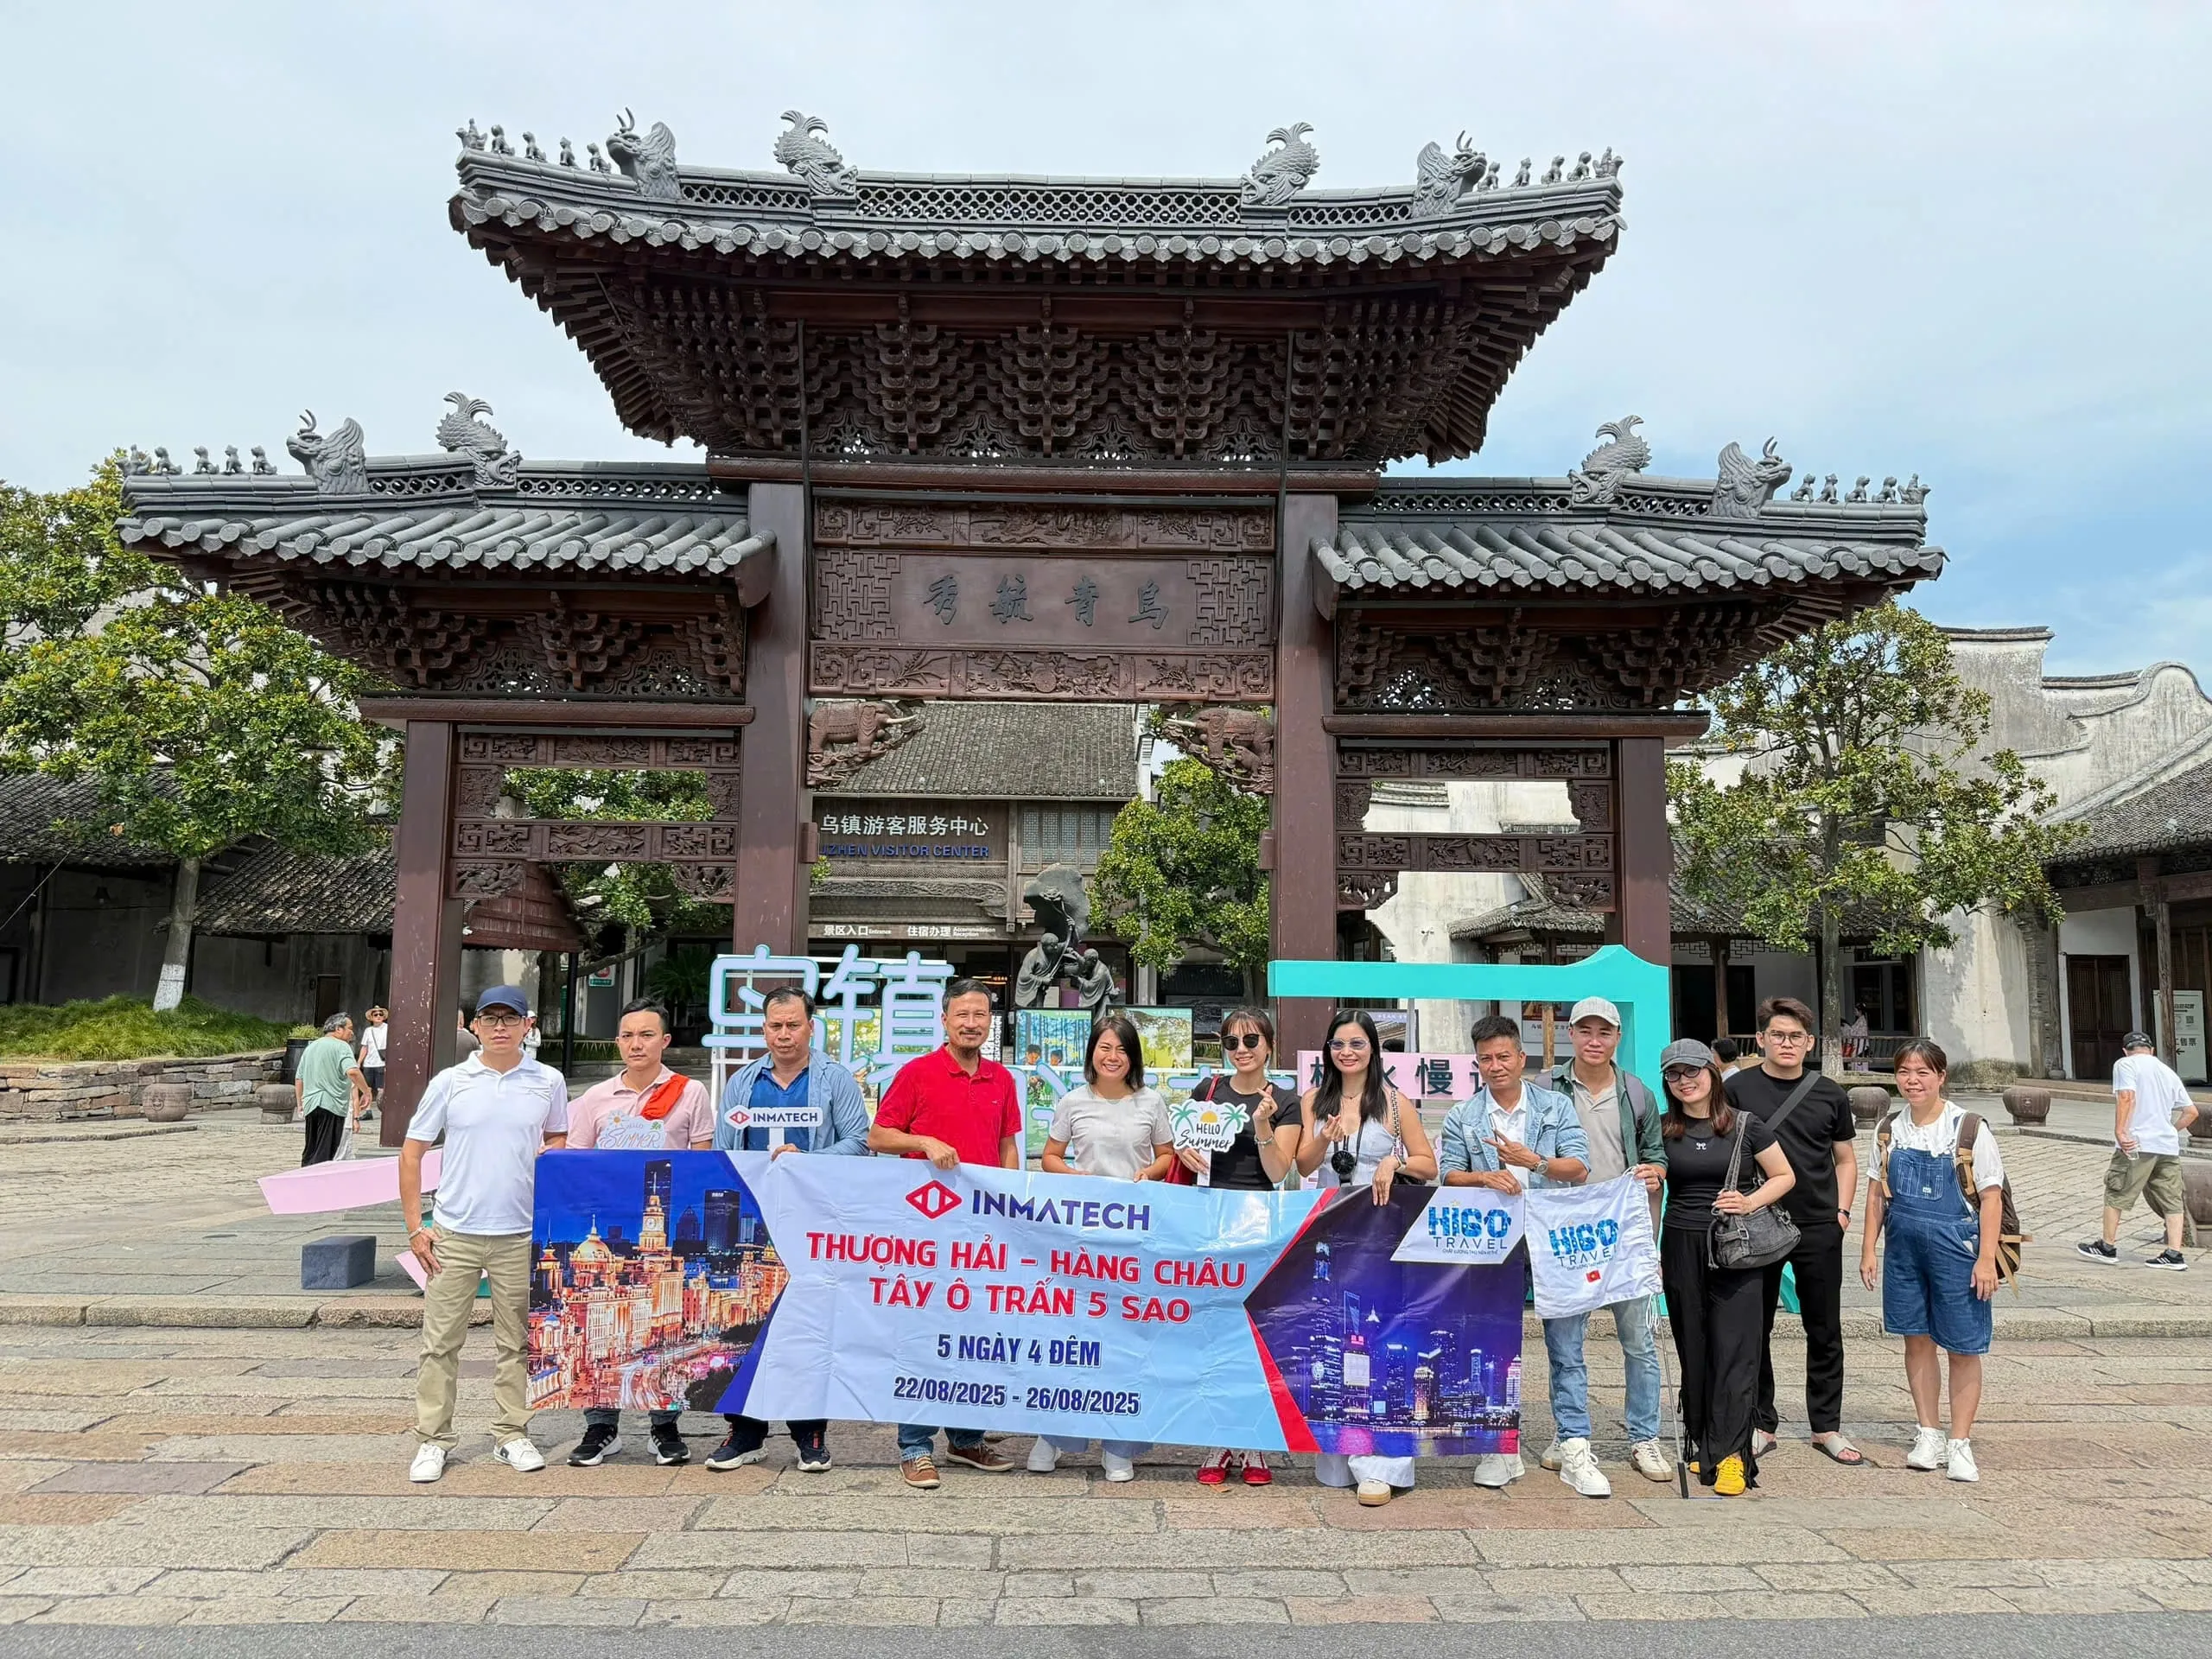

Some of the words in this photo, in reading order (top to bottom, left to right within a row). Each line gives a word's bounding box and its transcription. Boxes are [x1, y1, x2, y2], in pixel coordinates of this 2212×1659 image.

[821, 814, 989, 836] 乌镇游客服务中心
[871, 843, 930, 856] VISITOR
[933, 844, 988, 858] CENTER
[823, 925, 868, 936] 景区入口
[907, 925, 950, 938] 住宿办理
[753, 1113, 817, 1122] INMATECH
[1177, 1129, 1231, 1148] Summer
[1197, 1123, 1220, 1135] HELLO
[971, 1189, 1150, 1230] INMATECH
[1433, 1236, 1508, 1249] TRAVEL
[805, 1231, 938, 1271] THƯỢNG
[950, 1234, 1008, 1271] HẢI
[1051, 1247, 1141, 1283] HÀNG
[1154, 1256, 1246, 1288] CHÂU
[869, 1273, 935, 1309] TÂY
[946, 1277, 971, 1312] Ô
[985, 1277, 1076, 1317] TRẤN
[1088, 1291, 1108, 1318] 5
[1122, 1295, 1192, 1324] SAO
[937, 1334, 951, 1358] 5
[958, 1332, 1021, 1363] NGÀY
[1028, 1339, 1042, 1364] 4
[1049, 1335, 1101, 1367] ĐÊM
[893, 1376, 1006, 1406] 22/08/2025
[1026, 1387, 1140, 1414] 26/08/2025
